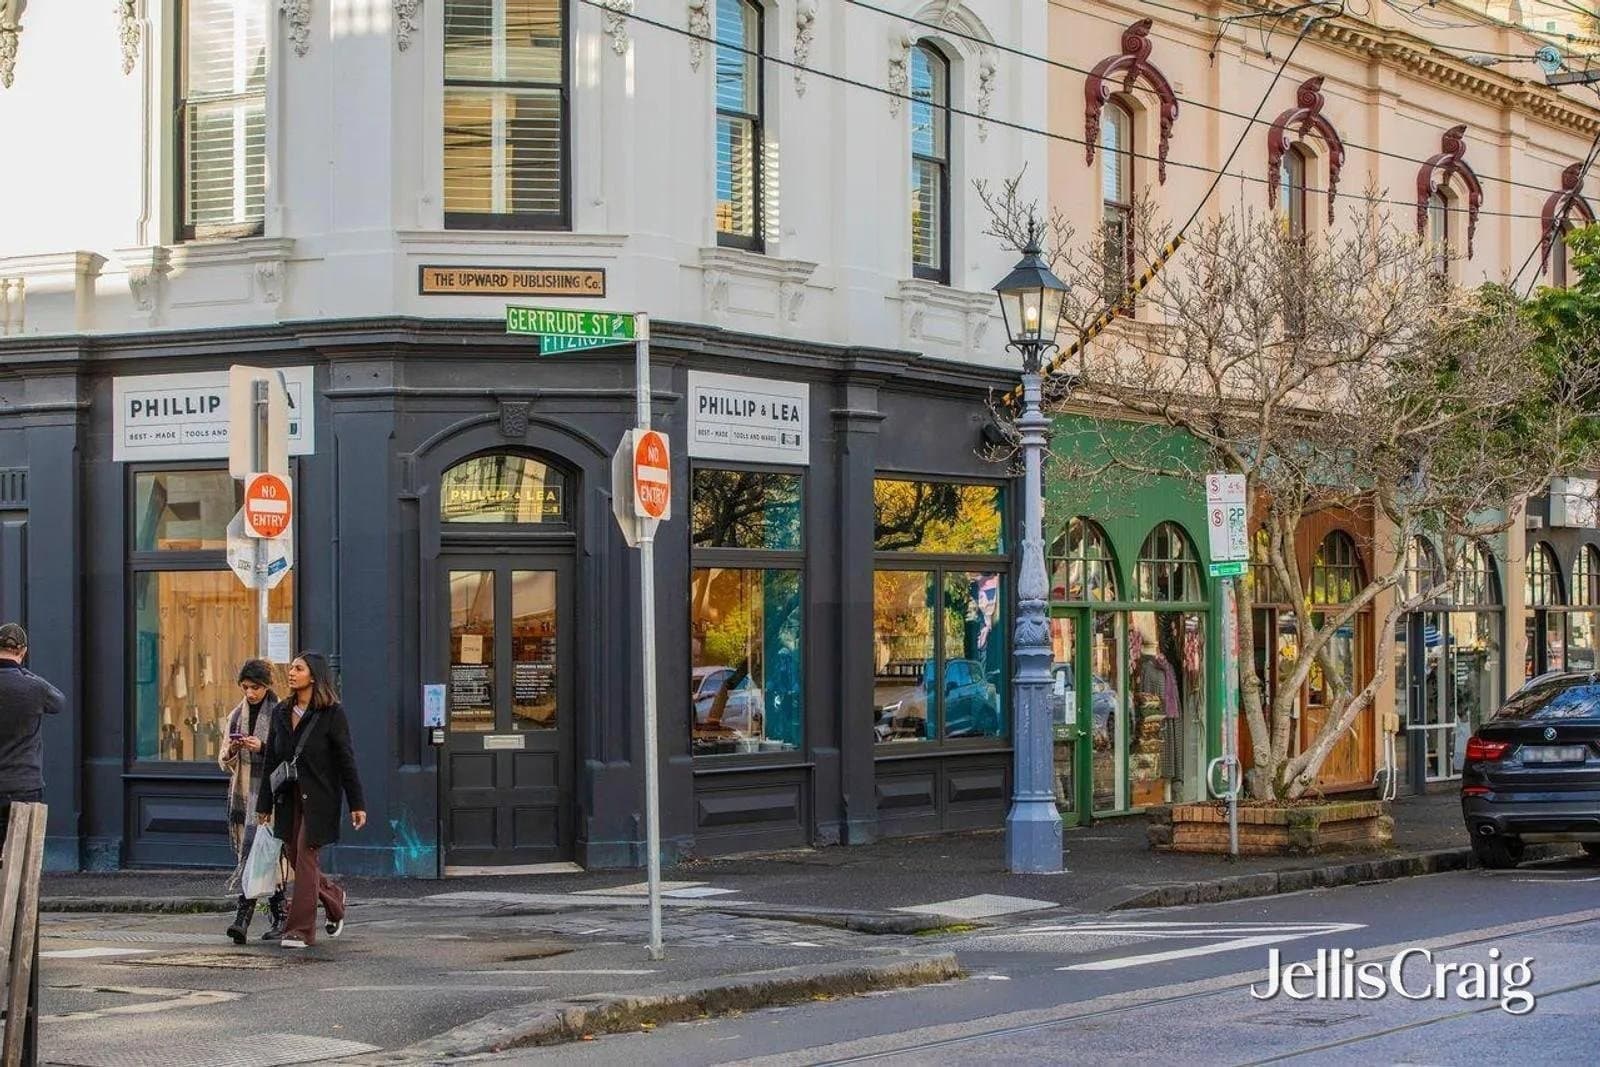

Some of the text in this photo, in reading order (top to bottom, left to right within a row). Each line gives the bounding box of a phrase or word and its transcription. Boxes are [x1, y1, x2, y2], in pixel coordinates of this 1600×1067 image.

[434, 272, 454, 287] THE
[458, 272, 508, 288] UPWARD
[513, 273, 580, 289] PUBLISHING
[508, 307, 609, 336] GERTRUDE ST
[130, 395, 221, 418] PHILLIP
[699, 395, 800, 422] PHILLIP & LEA
[129, 433, 147, 441] BEST
[155, 431, 176, 439] MADE
[185, 428, 228, 438] TOOLS AND
[714, 430, 728, 438] MADE
[733, 431, 749, 440] TOOLS
[749, 433, 760, 441] AND
[648, 445, 659, 464] NO
[261, 485, 276, 498] NO
[450, 490, 510, 501] PHILLIP
[526, 490, 556, 501] LEA
[640, 485, 665, 506] ENTRY
[252, 514, 285, 528] ENTRY
[1229, 507, 1245, 521] 2P
